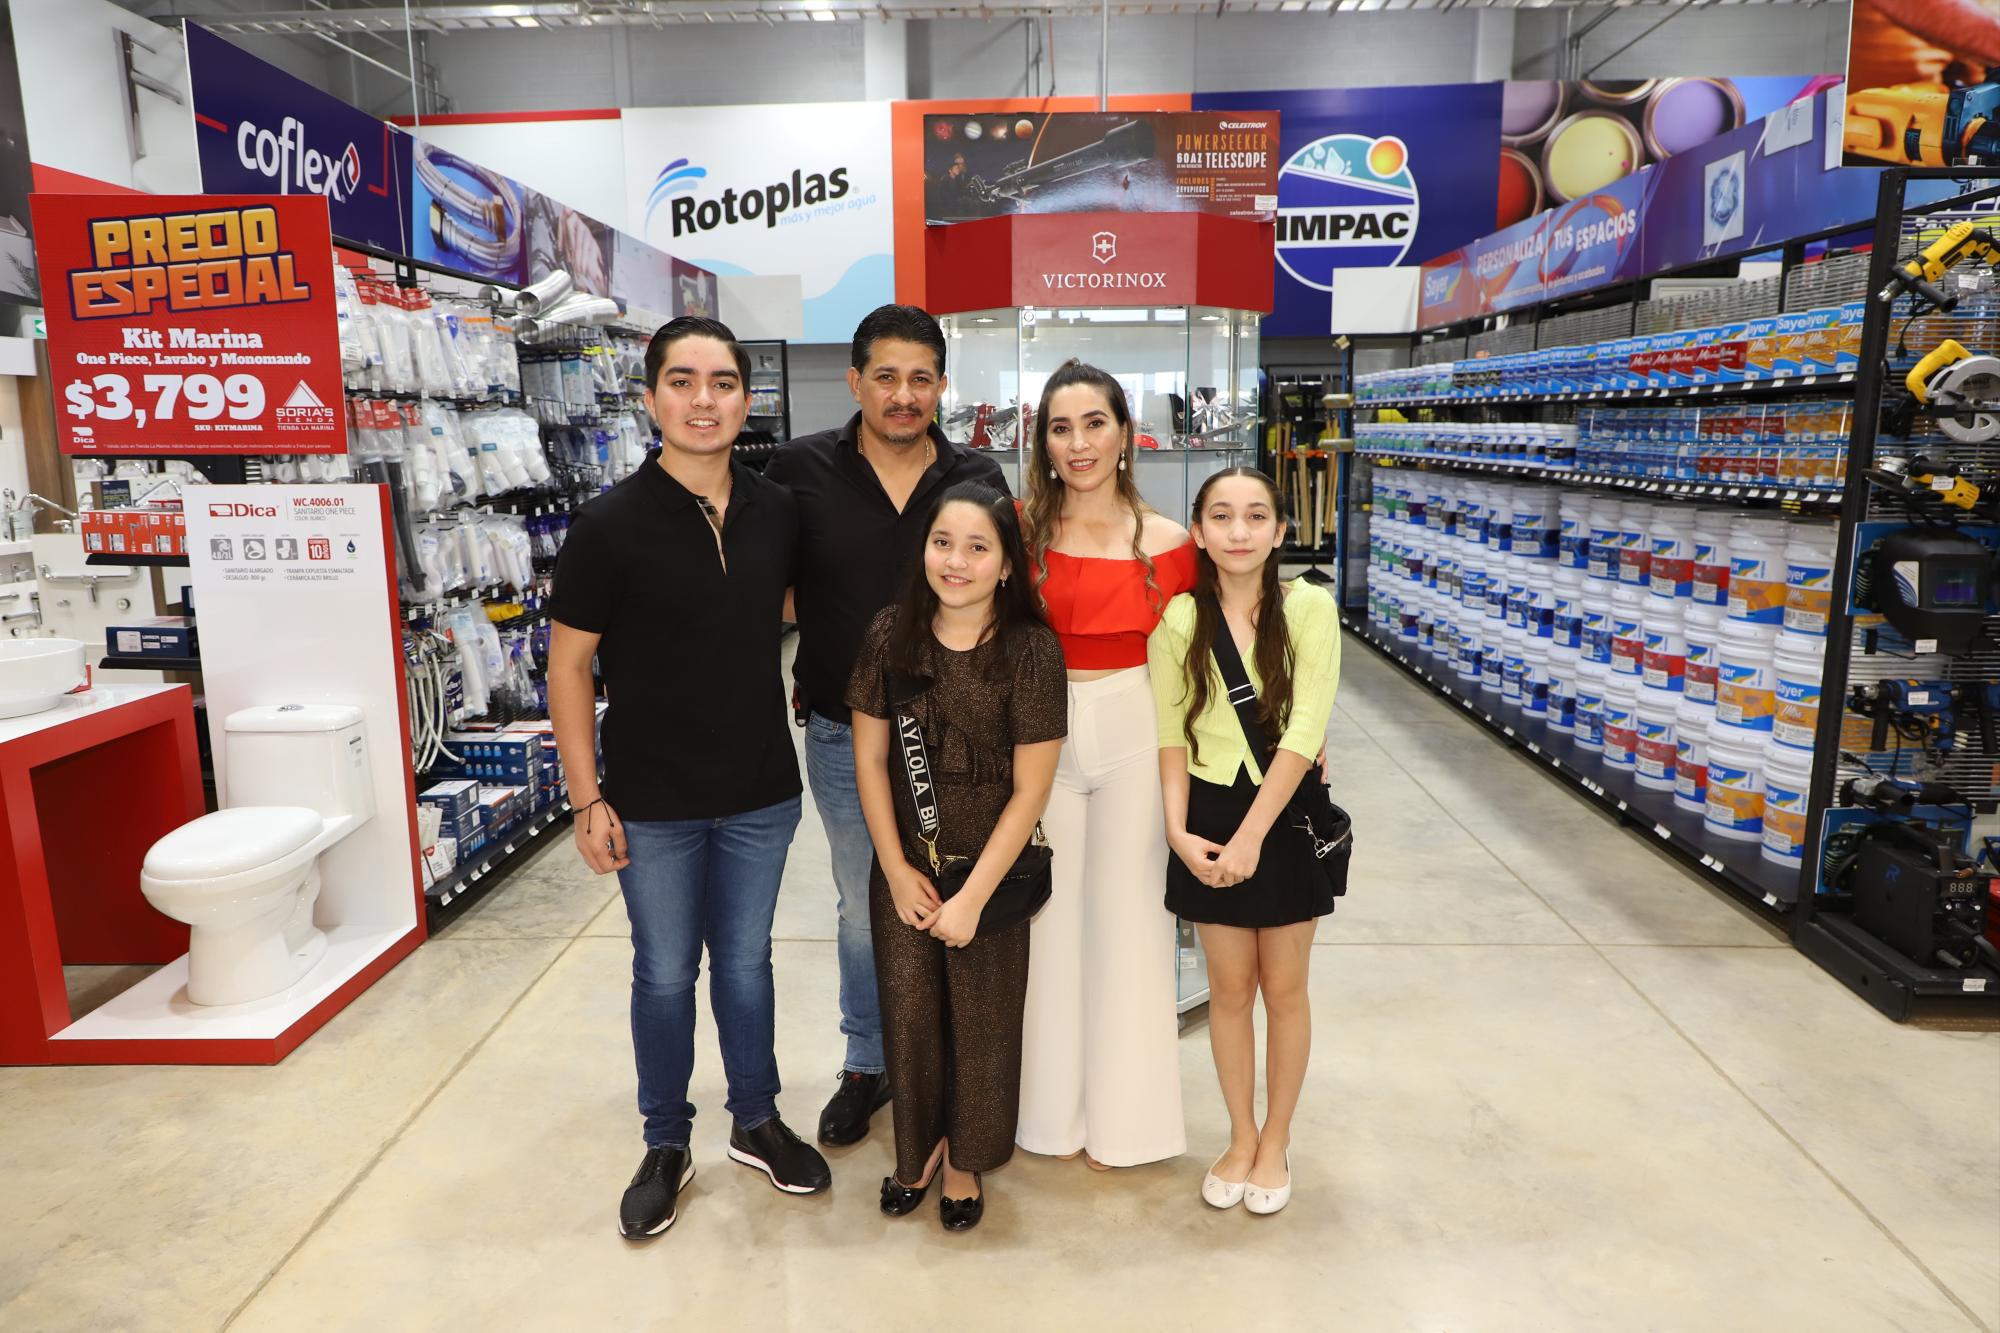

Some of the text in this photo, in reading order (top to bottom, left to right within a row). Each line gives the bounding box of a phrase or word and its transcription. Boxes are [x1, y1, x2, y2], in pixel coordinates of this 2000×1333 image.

[1176, 134, 1267, 151] POWERSEEKER
[237, 116, 341, 201] coflex
[1205, 152, 1267, 168] TELESCOPE
[671, 167, 849, 238] Rotoplas
[805, 211, 813, 222] y
[814, 201, 845, 218] mejor
[1276, 212, 1409, 241] IMPAC
[90, 206, 280, 268] PRECIO
[1476, 208, 1636, 276] PERSONALIZA TUS ESPACIOS
[70, 254, 310, 319] ESPECIAL
[1042, 273, 1166, 289] VICTORINOX
[1808, 314, 1830, 328] yer
[1840, 307, 1864, 320] Saye
[1778, 318, 1808, 332] Saye
[122, 328, 264, 349] Kit Marina
[76, 353, 311, 368] One Piece, Lavabo y Monomando
[64, 373, 266, 429] $3,799
[276, 407, 334, 417] SORIA'S
[194, 424, 264, 432] SKU: KITMARINA
[234, 503, 277, 517] Dica
[293, 498, 345, 507] WC.4006.01
[310, 545, 323, 559] 10
[1950, 882, 1974, 893] 888
